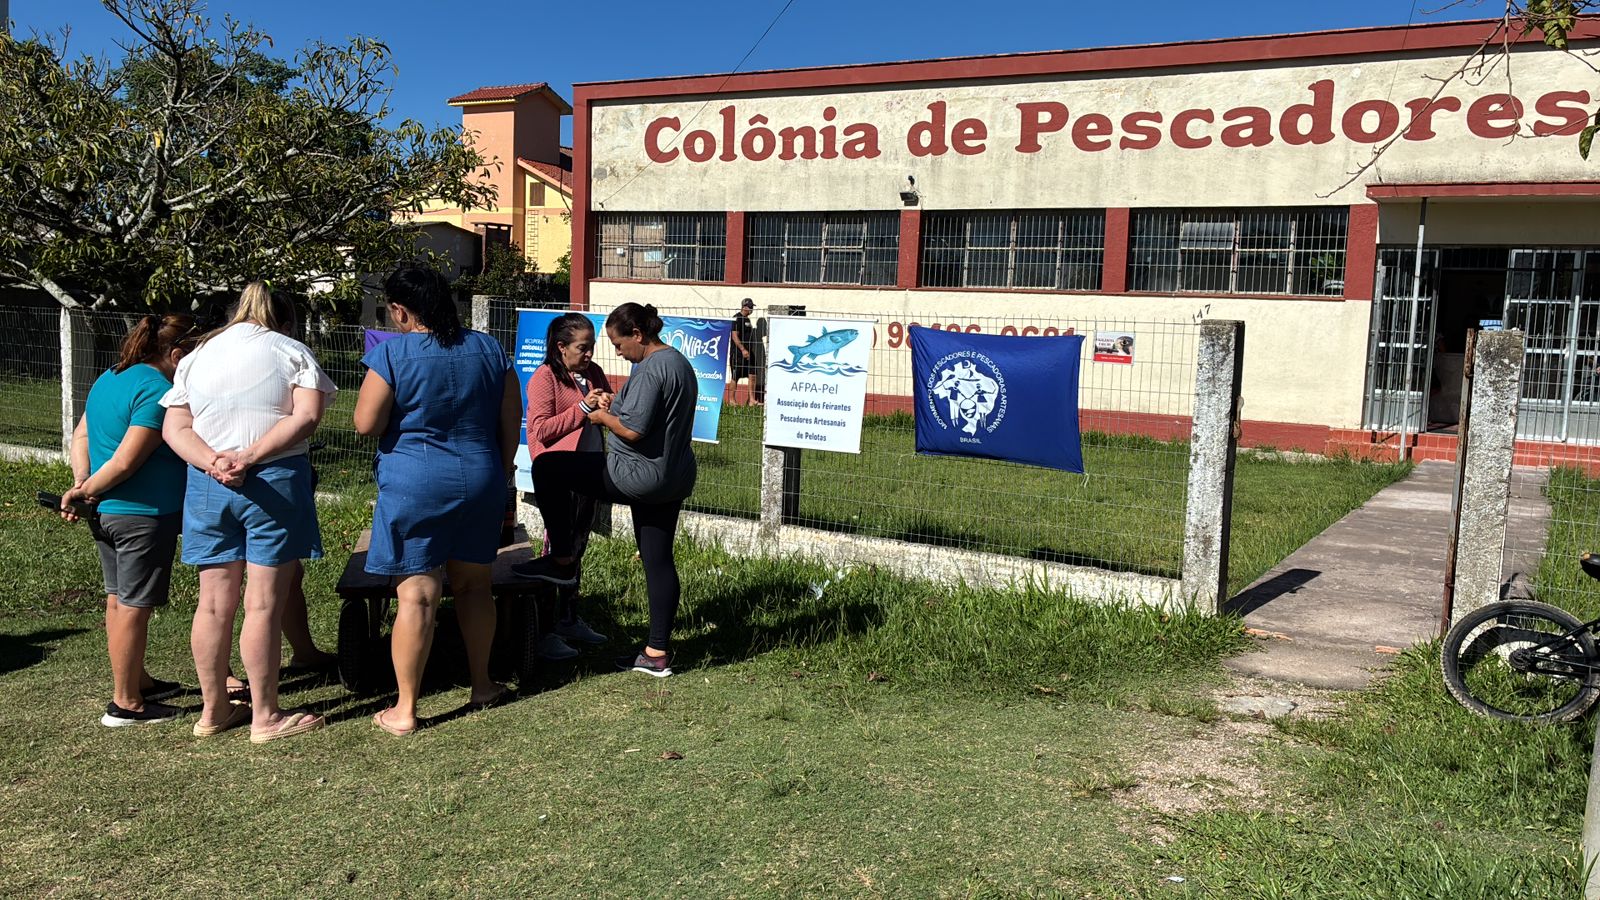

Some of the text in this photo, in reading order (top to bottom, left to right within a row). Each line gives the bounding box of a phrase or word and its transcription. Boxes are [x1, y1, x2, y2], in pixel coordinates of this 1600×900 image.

[644, 79, 1591, 163] Colônia de Pescadores
[927, 373, 937, 389] DOS
[971, 351, 977, 359] E
[976, 353, 1007, 394] PESCADORAS
[791, 382, 839, 395] AFPA-Pel
[777, 398, 852, 412] Associação dos Feirantes
[780, 414, 846, 428] Pescadores Artesanais
[796, 431, 827, 442] de Pelotas
